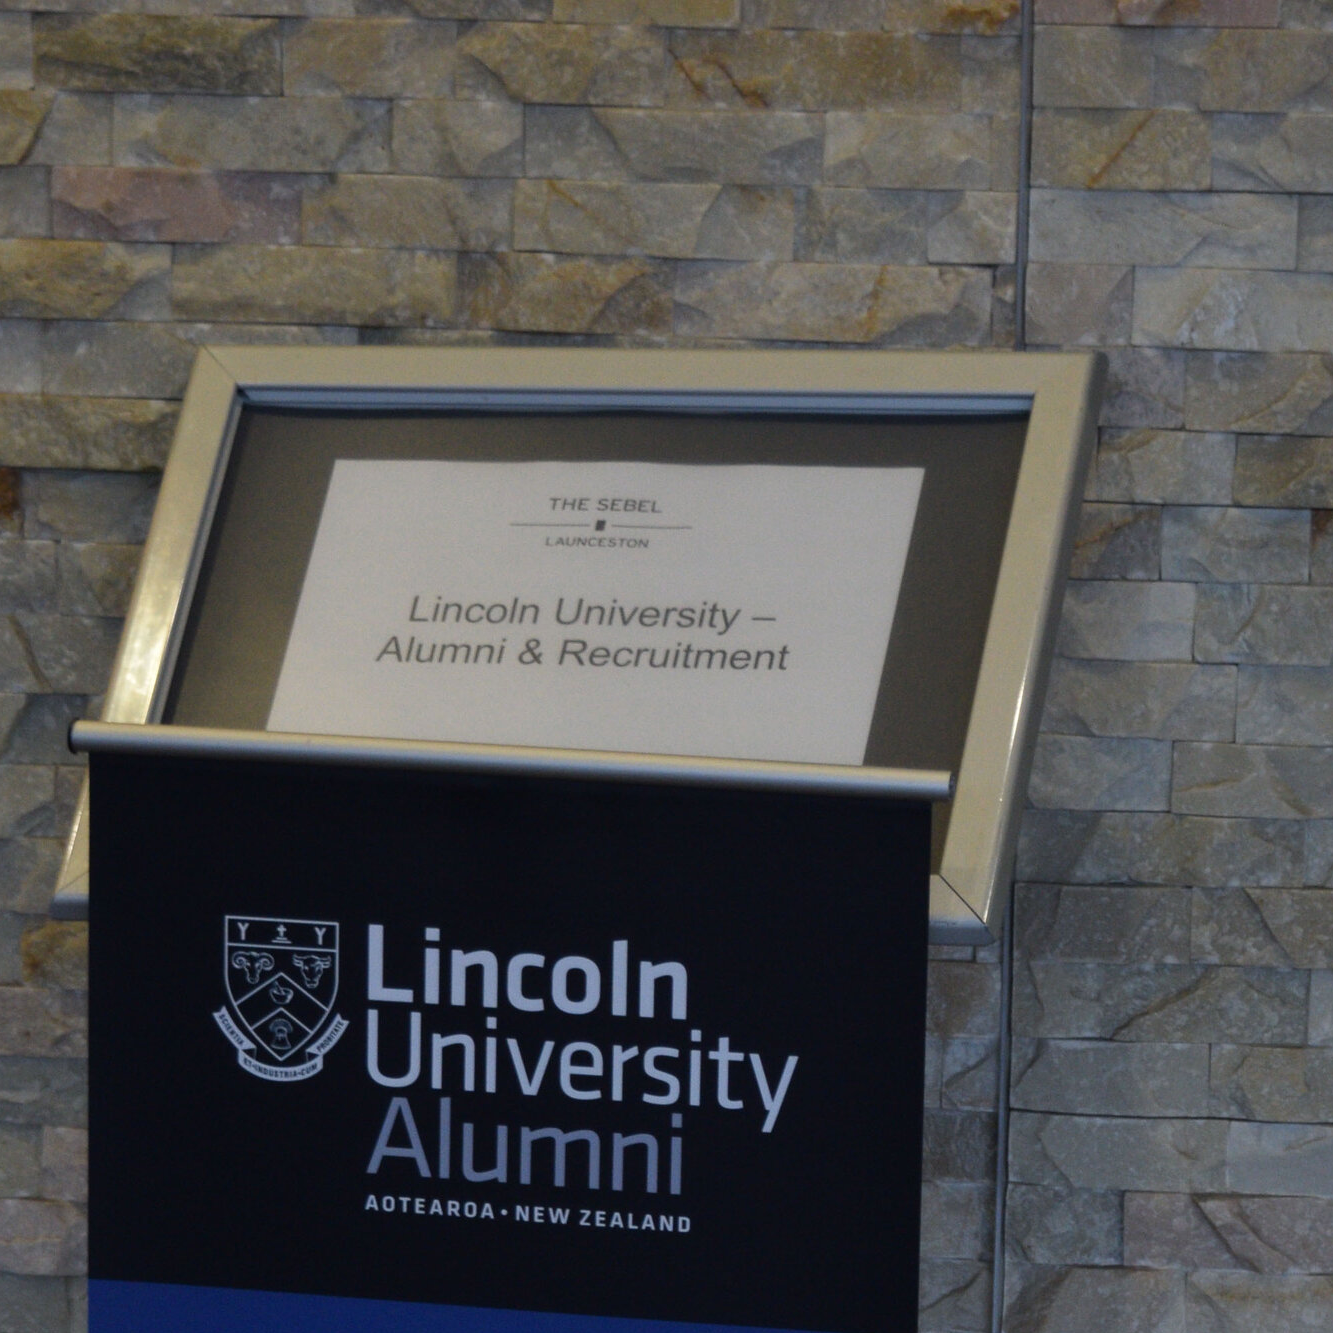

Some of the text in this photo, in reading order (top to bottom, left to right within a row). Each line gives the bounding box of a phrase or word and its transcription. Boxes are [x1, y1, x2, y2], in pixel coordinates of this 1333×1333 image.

[549, 498, 662, 514] THE SEBEL
[545, 536, 649, 549] LAUNCESTON
[409, 596, 541, 625] Lincoln
[555, 598, 741, 636] University
[376, 636, 790, 671] Alumni & Recruitment
[368, 923, 688, 1020] Lincoln
[367, 1009, 799, 1133] University
[367, 1096, 683, 1195] Alumni
[365, 1195, 691, 1233] AOTEAROA NEW ZEALAND
